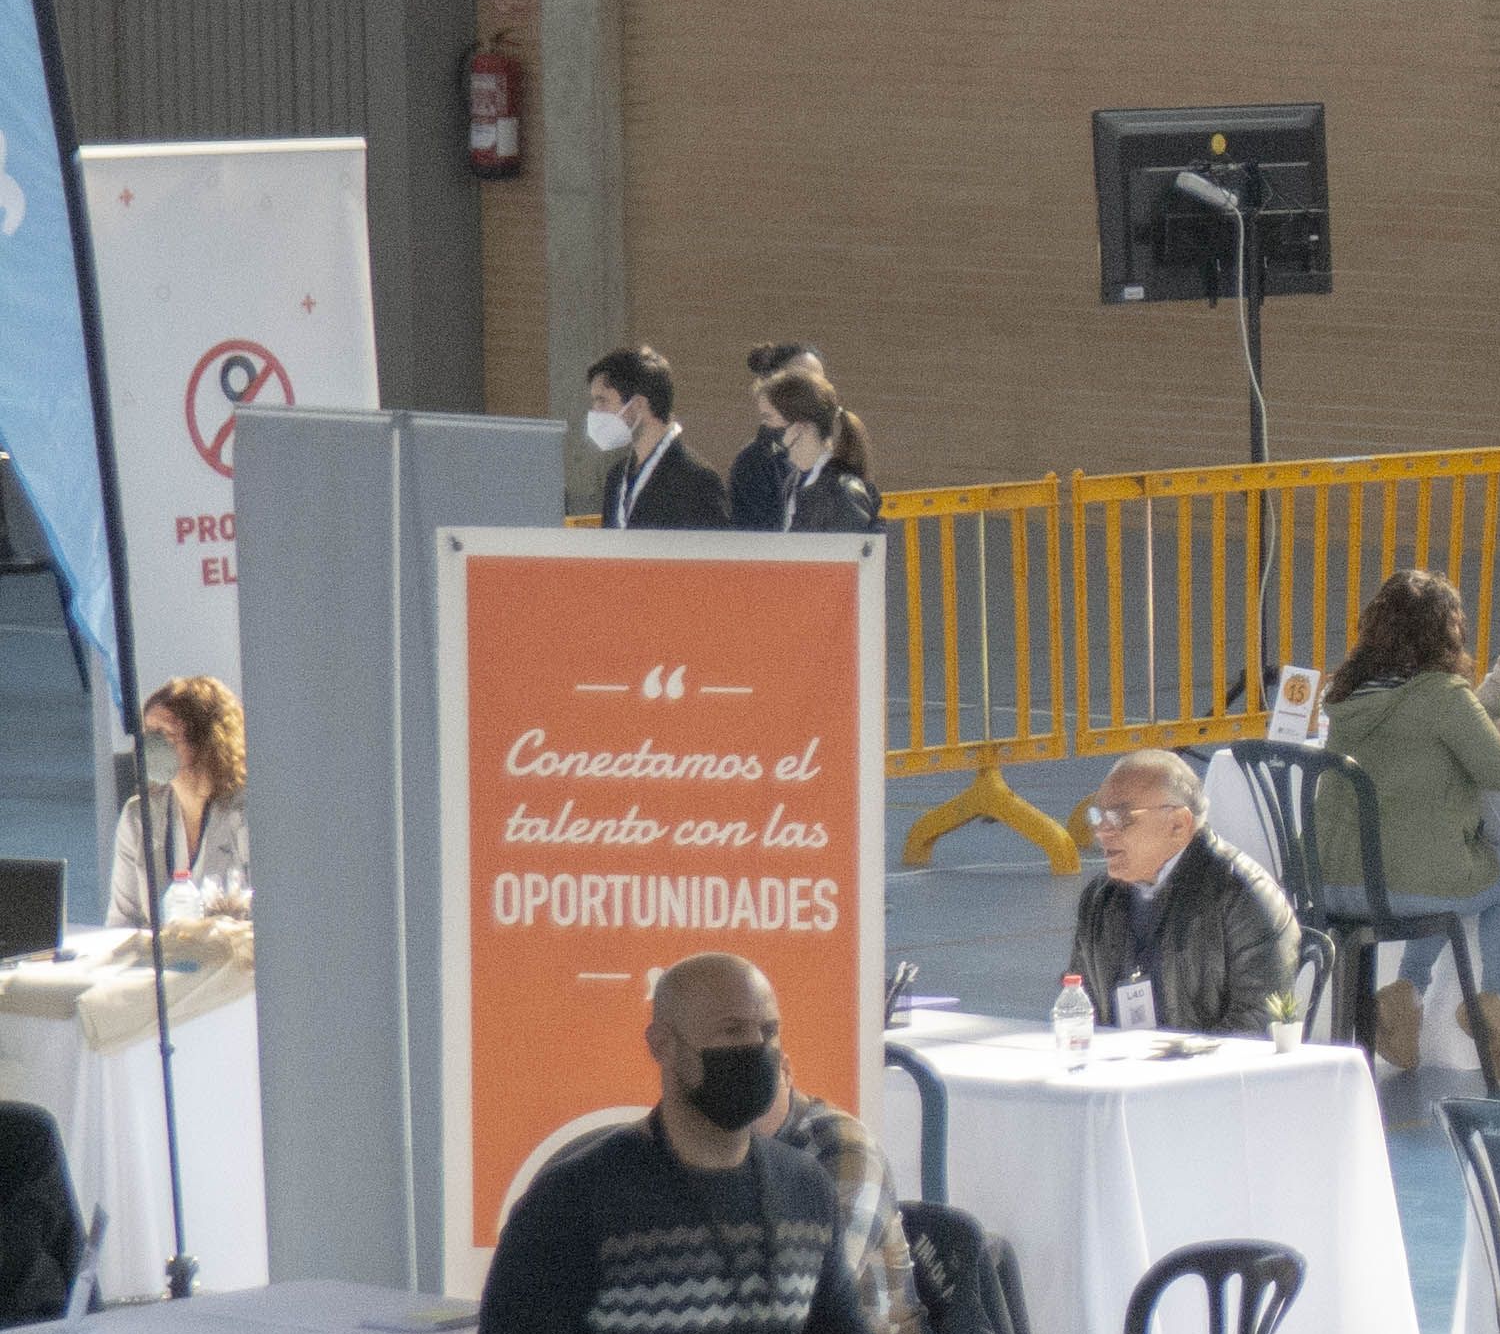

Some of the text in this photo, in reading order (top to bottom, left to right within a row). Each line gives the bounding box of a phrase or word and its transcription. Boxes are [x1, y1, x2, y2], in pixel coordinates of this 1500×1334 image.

[1288, 683, 1306, 701] 15
[506, 728, 821, 782] Conectamos el
[505, 799, 829, 849] talento con las
[493, 871, 839, 932] OPORTUNIDADES
